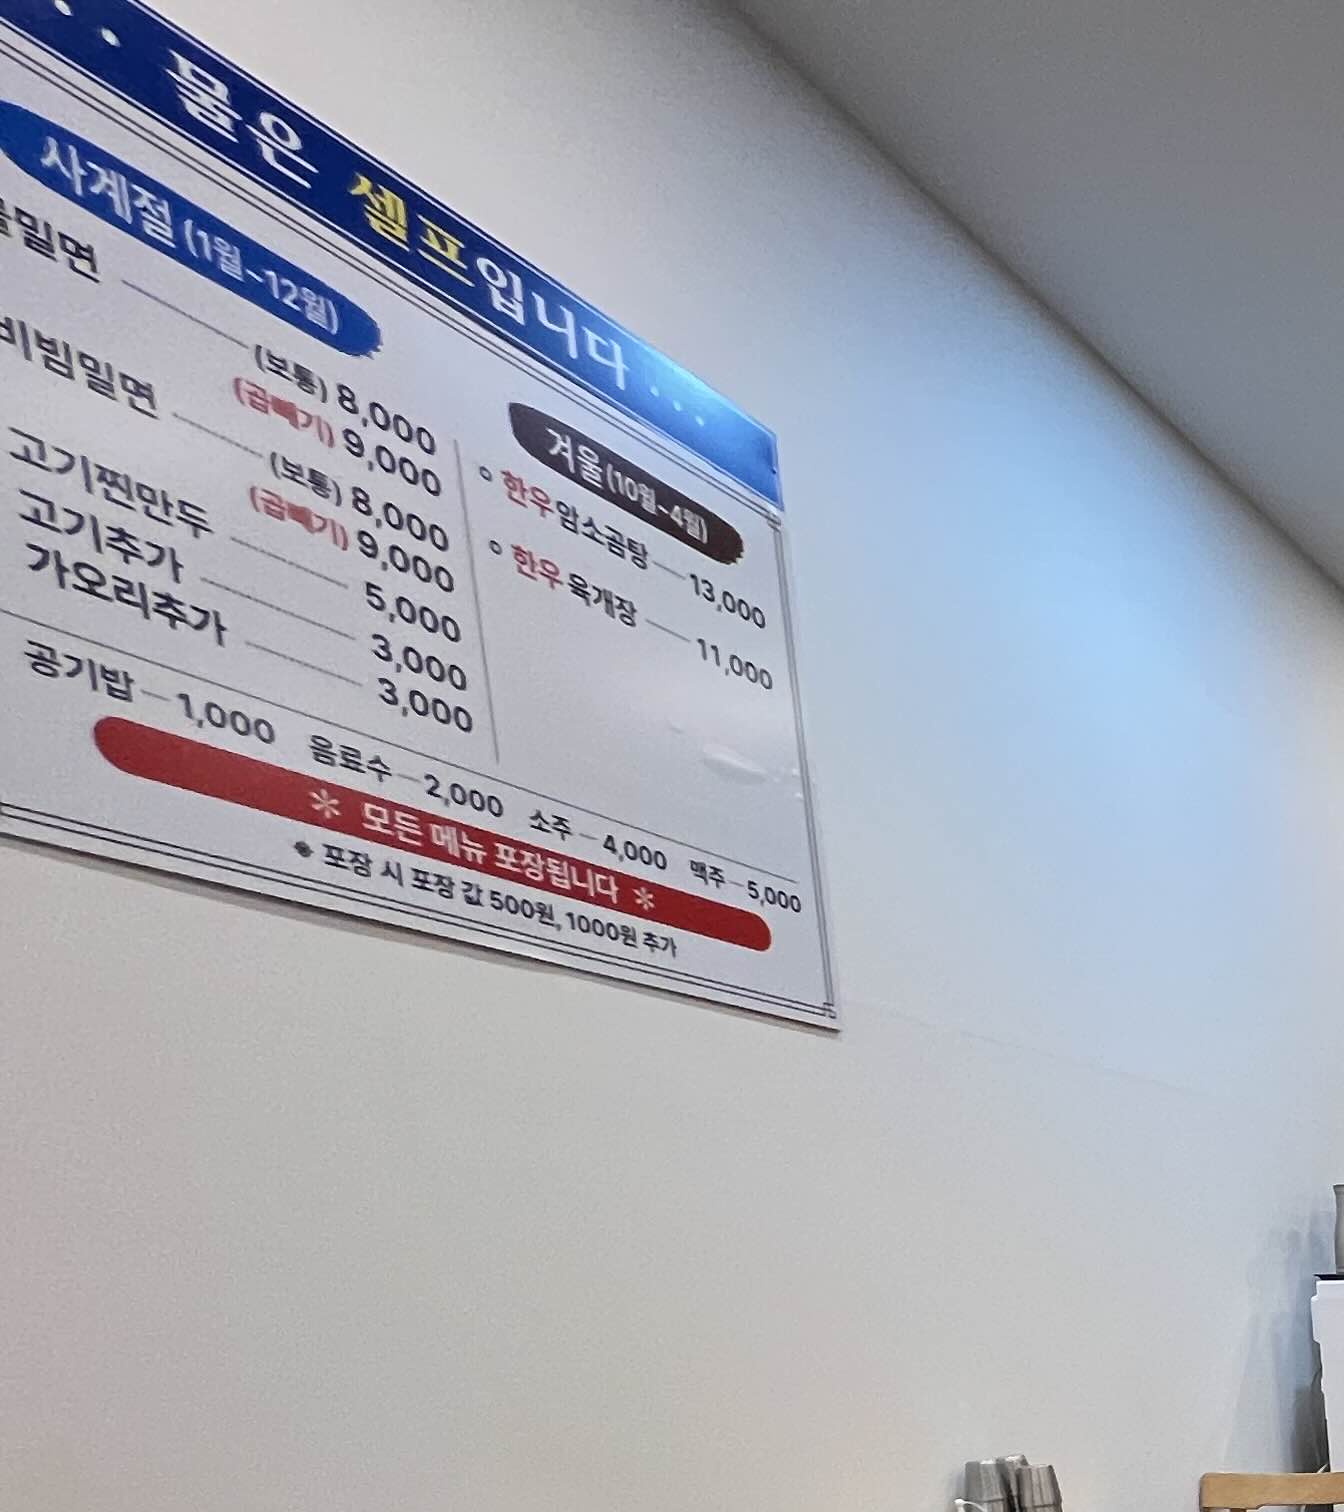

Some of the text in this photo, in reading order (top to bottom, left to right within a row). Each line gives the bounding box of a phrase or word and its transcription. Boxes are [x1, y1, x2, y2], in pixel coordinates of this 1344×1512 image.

[166, 49, 320, 189] 물은
[40, 136, 176, 248] 사계절
[0, 196, 100, 283] 밀면
[337, 383, 436, 455] 8,000
[341, 428, 442, 497] 9,000
[351, 486, 449, 552] 8,000
[8, 426, 461, 642] 고기찐만두 5,000
[18, 488, 467, 691] 고기추가 3,000
[358, 529, 455, 593] 9,000
[26, 543, 474, 734] 가오리추가 3,000
[690, 573, 766, 630] 13,000
[697, 638, 773, 690] 11,000
[24, 640, 802, 914] 공기밥 1,000 음료수 2,000 소주 4,000 맥주 5,000
[322, 843, 372, 876] 포장
[382, 857, 404, 887] 시
[411, 864, 455, 900] 포장
[567, 911, 638, 949] 1000원
[643, 933, 678, 958] 추가
[360, 802, 620, 905] 모든 메뉴 포장됩니다
